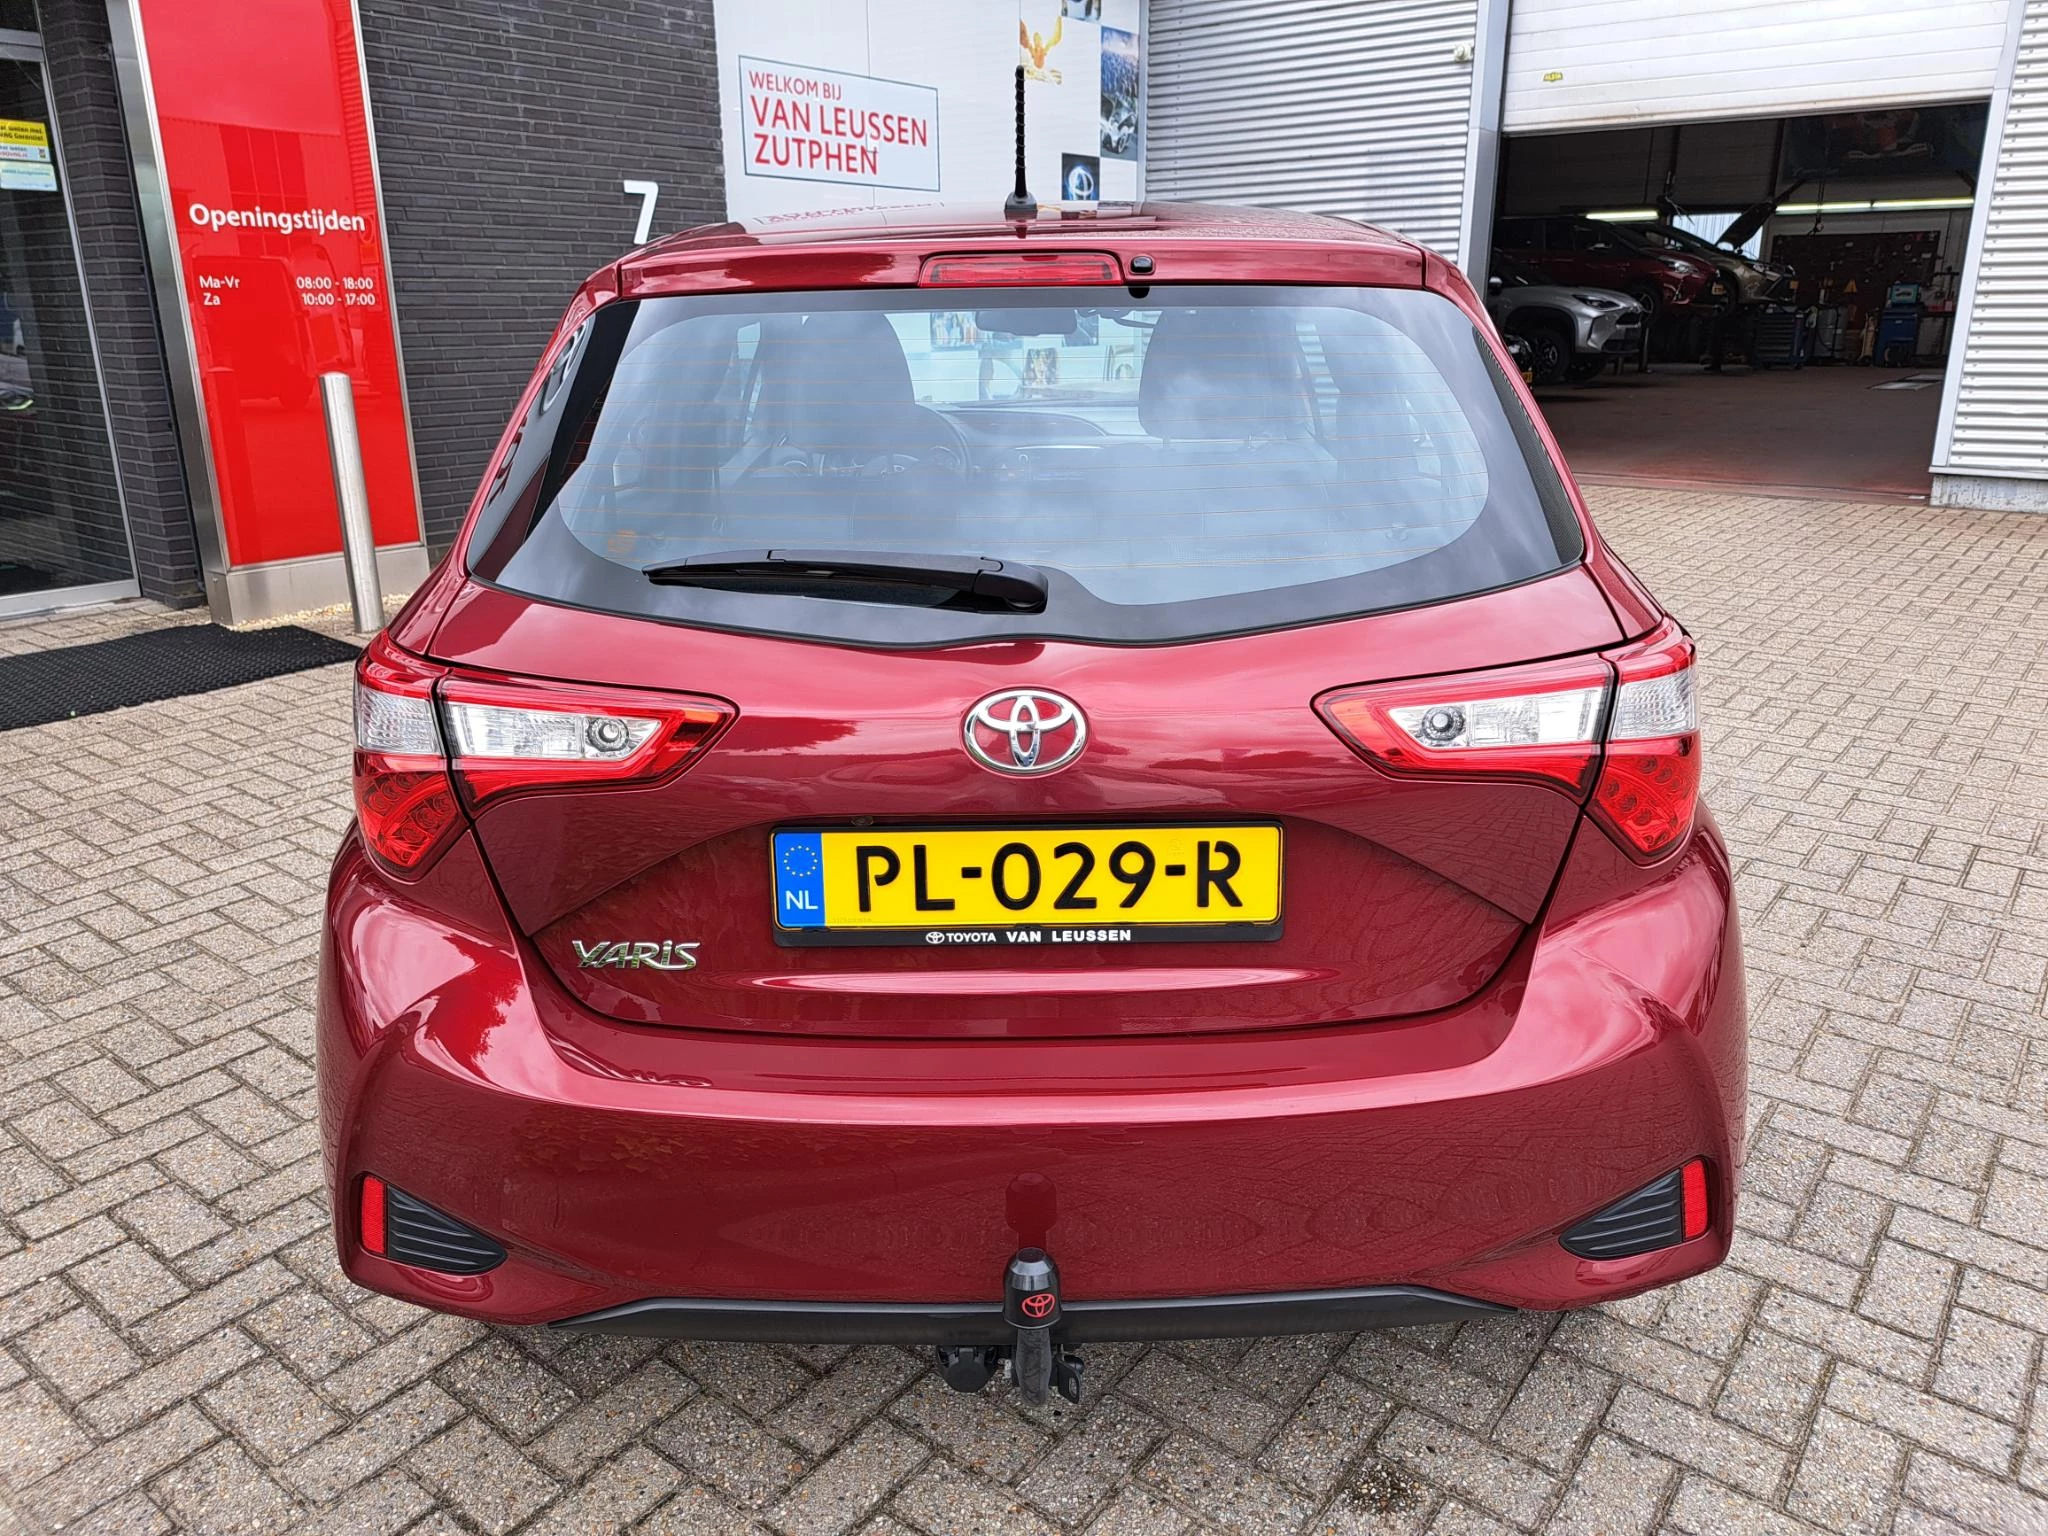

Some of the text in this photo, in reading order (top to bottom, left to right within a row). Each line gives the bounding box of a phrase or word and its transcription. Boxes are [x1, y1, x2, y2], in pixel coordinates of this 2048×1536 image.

[748, 70, 842, 101] WELKOM BIJ
[750, 95, 928, 147] VAN LEUSSEN
[754, 132, 879, 175] ZUTPHEN
[189, 203, 366, 235] Openingstijden
[623, 180, 659, 245] 7
[199, 275, 240, 289] Ma-Vr
[296, 277, 332, 290] 08:00
[342, 277, 374, 290] 18:00
[203, 292, 221, 306] Za
[302, 293, 334, 306] 10:00
[345, 293, 376, 306] 17:00
[855, 840, 1244, 913] PL-029-R
[785, 889, 819, 911] NL
[946, 930, 1131, 943] TOYOTA VAN LEUSSEN
